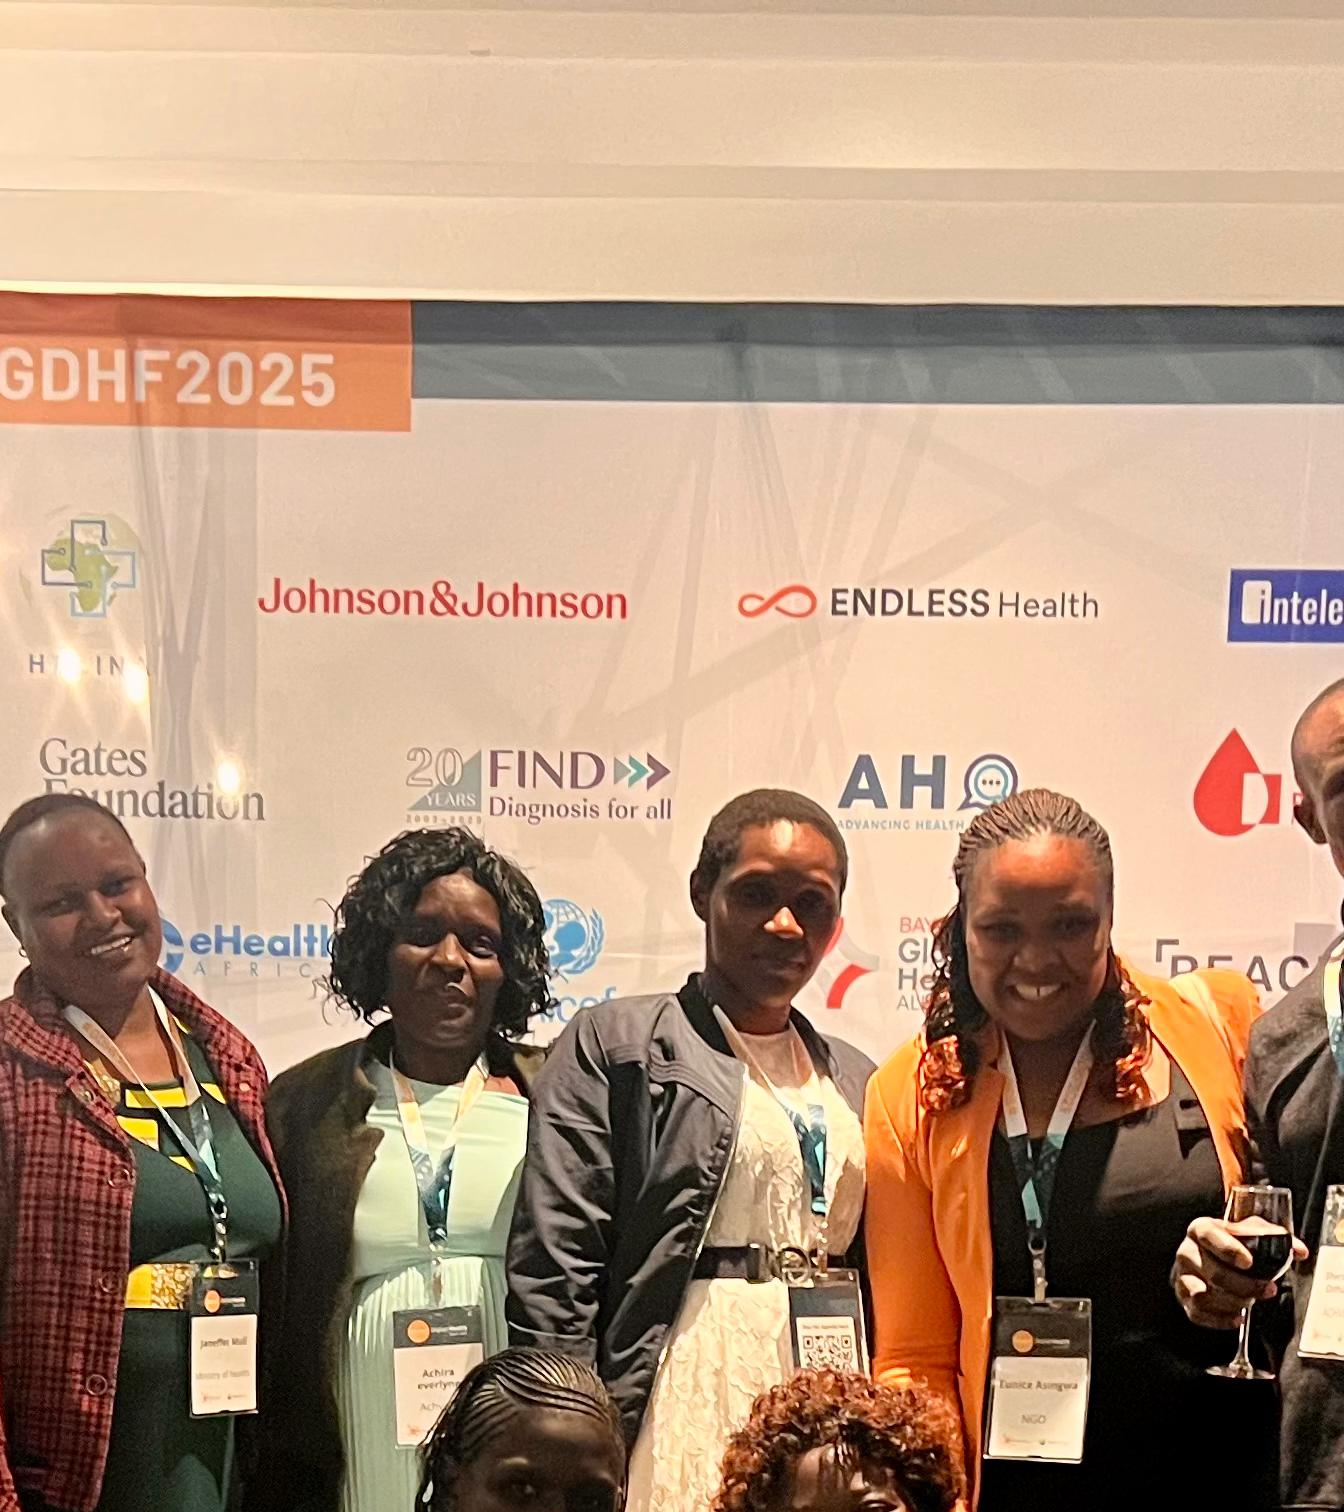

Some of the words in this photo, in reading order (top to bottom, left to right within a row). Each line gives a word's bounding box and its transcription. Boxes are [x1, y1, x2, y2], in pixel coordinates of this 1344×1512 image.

[258, 578, 627, 620] Johnson&Johnson
[831, 587, 989, 618] ENDLESS
[999, 590, 1099, 619] Health
[39, 738, 147, 778] Gates
[406, 747, 464, 787] 20
[489, 750, 605, 790] FIND
[489, 796, 599, 825] Diagnosis
[608, 797, 638, 820] for
[647, 798, 672, 820] all
[837, 819, 911, 831] ADVANCING
[915, 819, 965, 831] HEALTH
